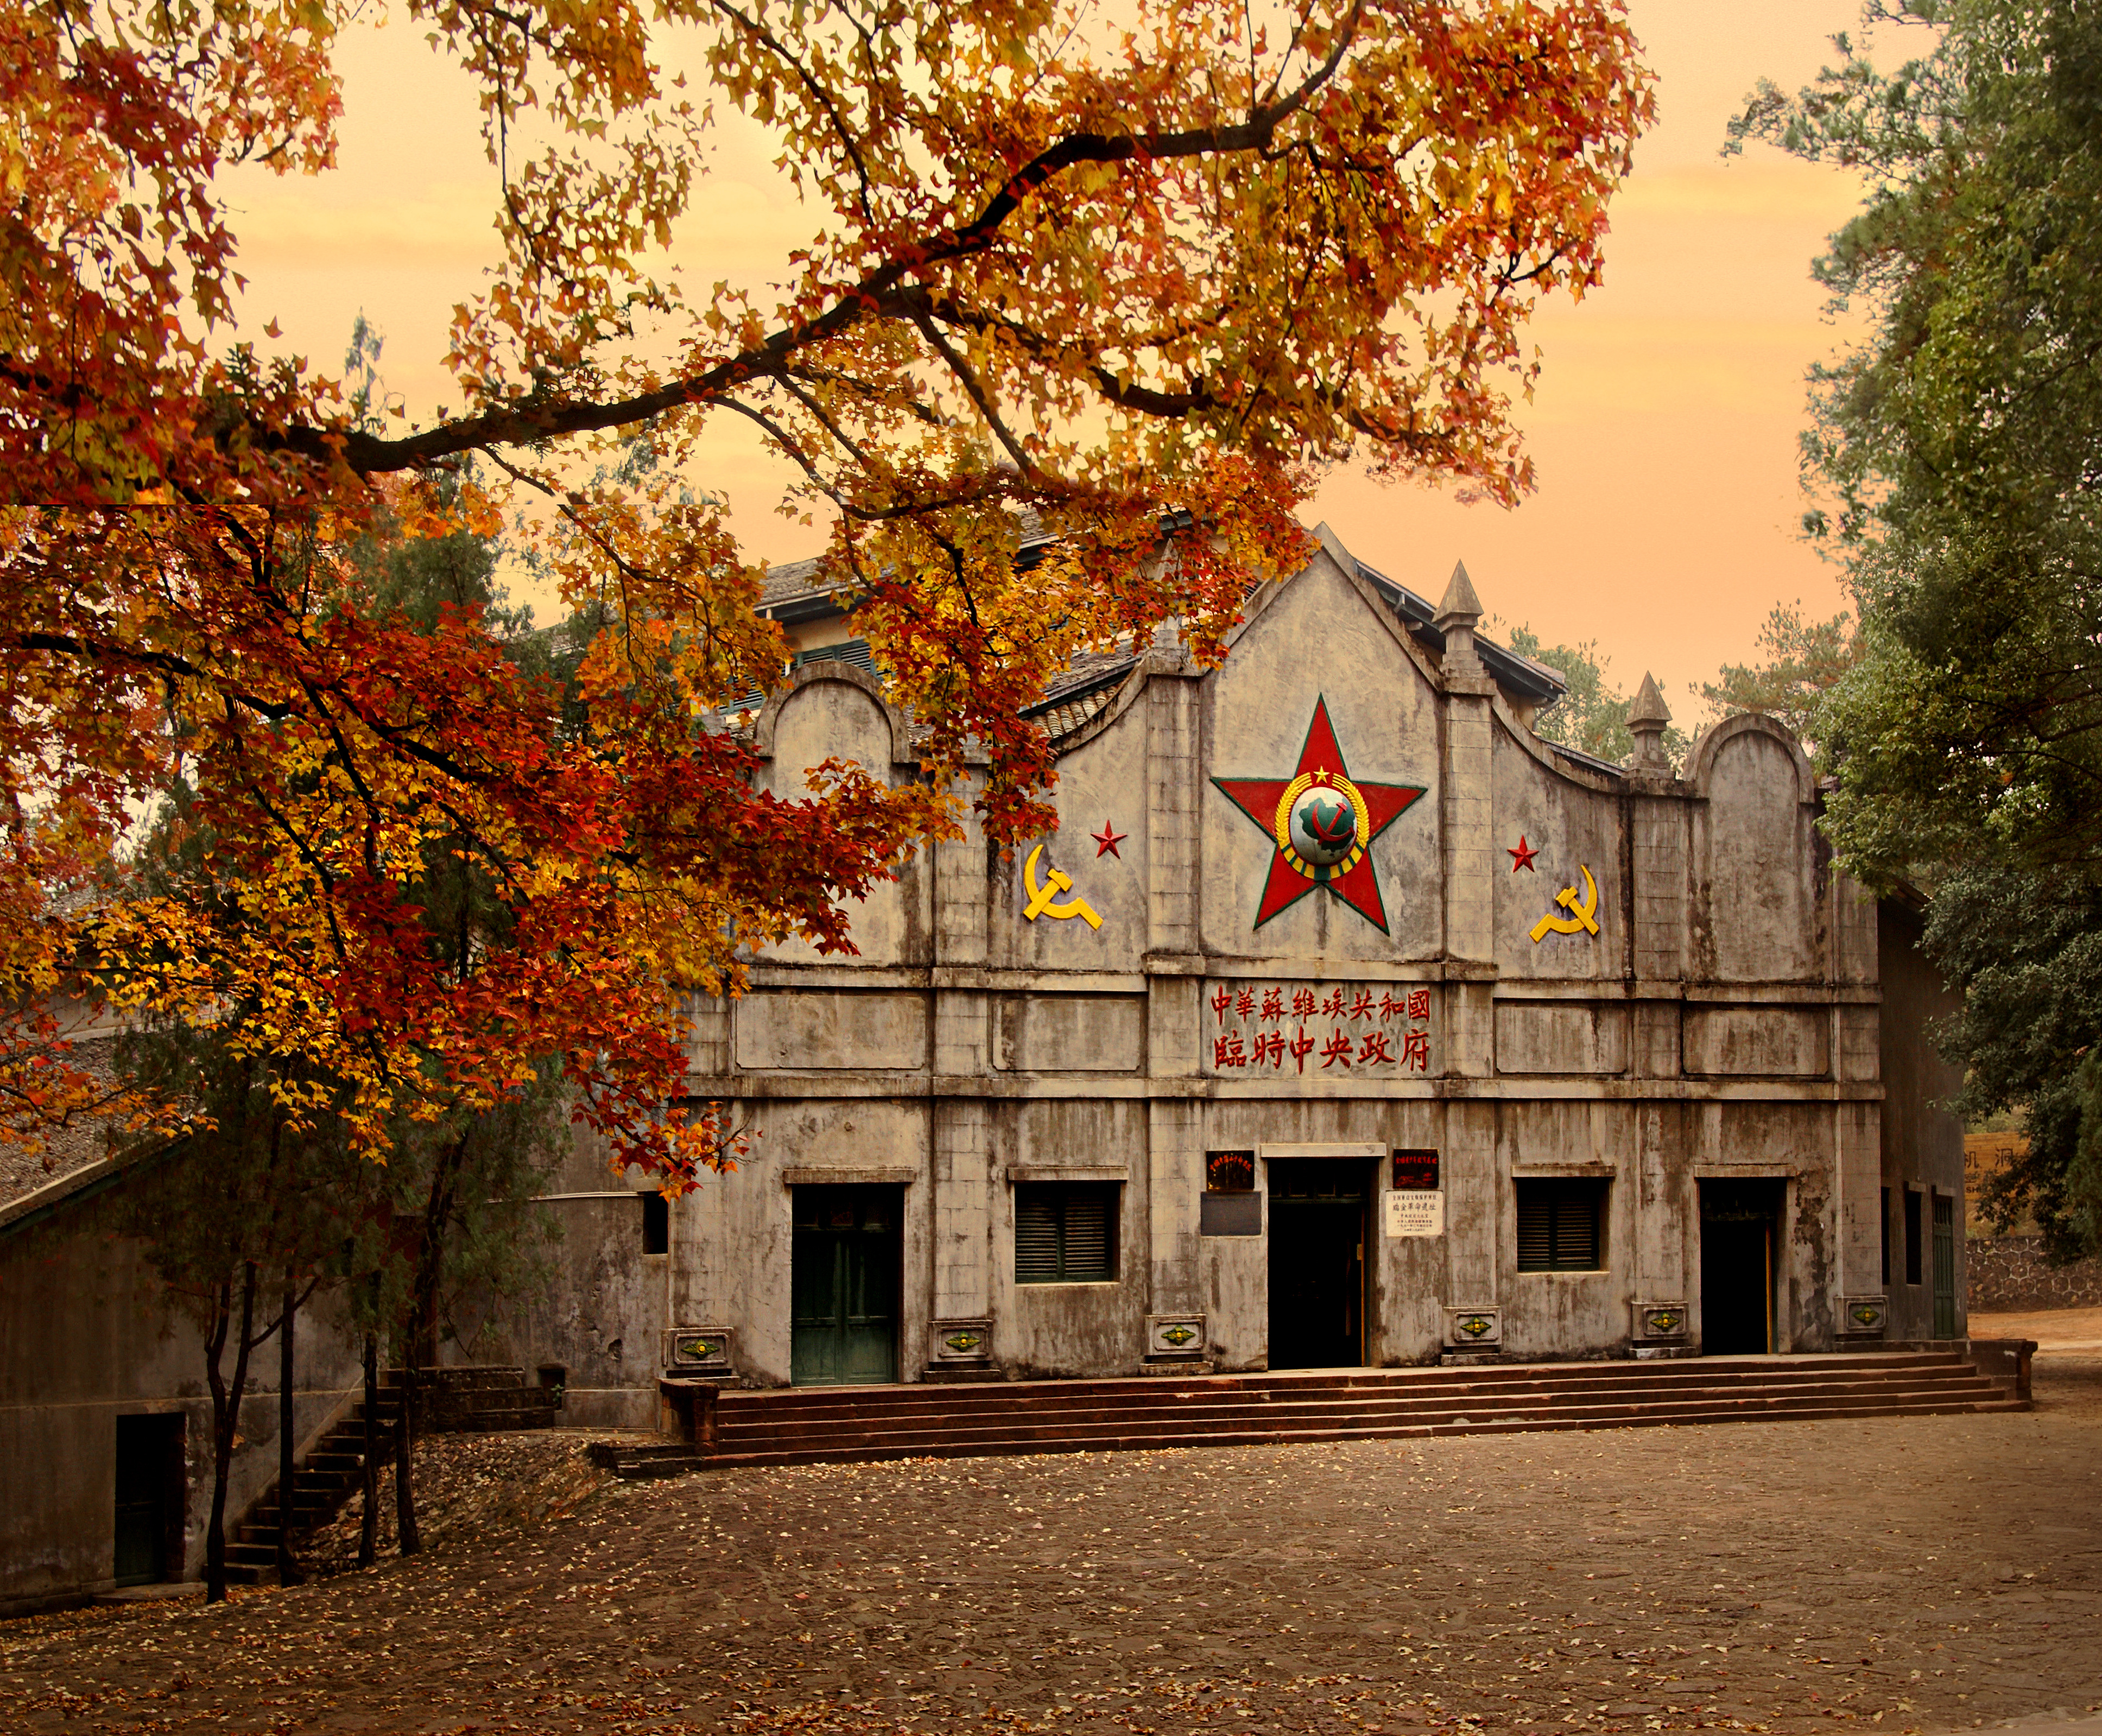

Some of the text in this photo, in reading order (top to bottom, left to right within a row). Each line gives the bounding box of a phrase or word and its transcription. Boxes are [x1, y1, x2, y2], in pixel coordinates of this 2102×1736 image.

[1211, 985, 1430, 1025] 中華蘇維埃共和國
[1213, 1025, 1430, 1075] 臨時中央政府
